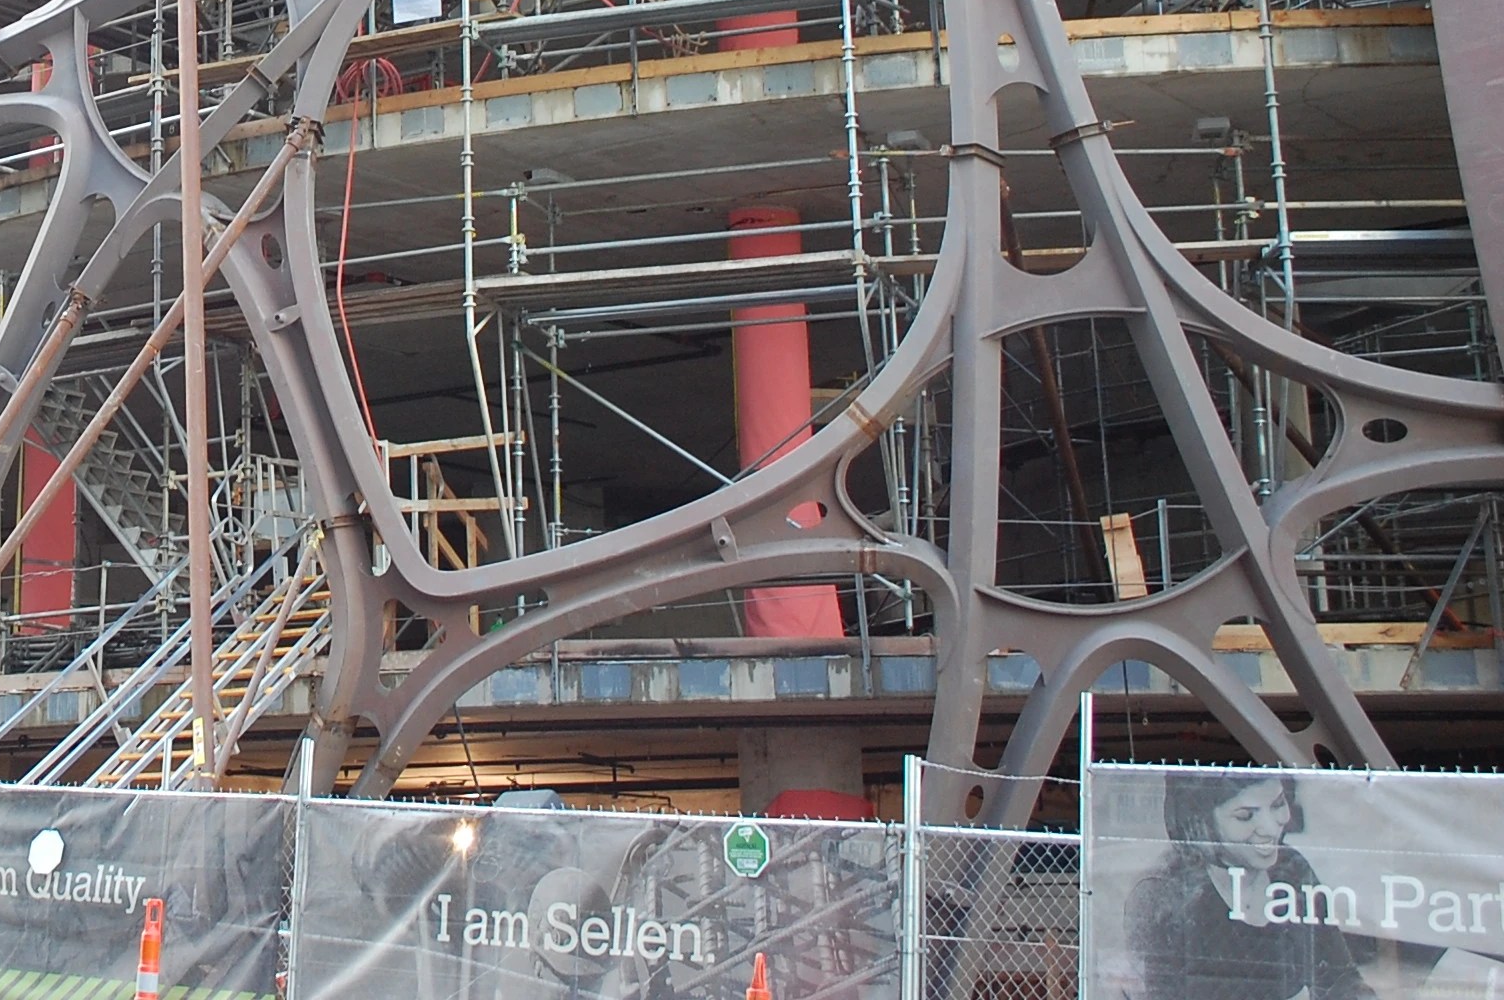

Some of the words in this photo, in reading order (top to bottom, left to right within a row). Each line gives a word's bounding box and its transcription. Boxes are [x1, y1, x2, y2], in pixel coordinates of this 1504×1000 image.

[1228, 866, 1246, 921] I
[1263, 881, 1362, 926] am
[436, 894, 452, 943] I
[463, 907, 531, 948] am
[544, 901, 715, 963] Sellen.
